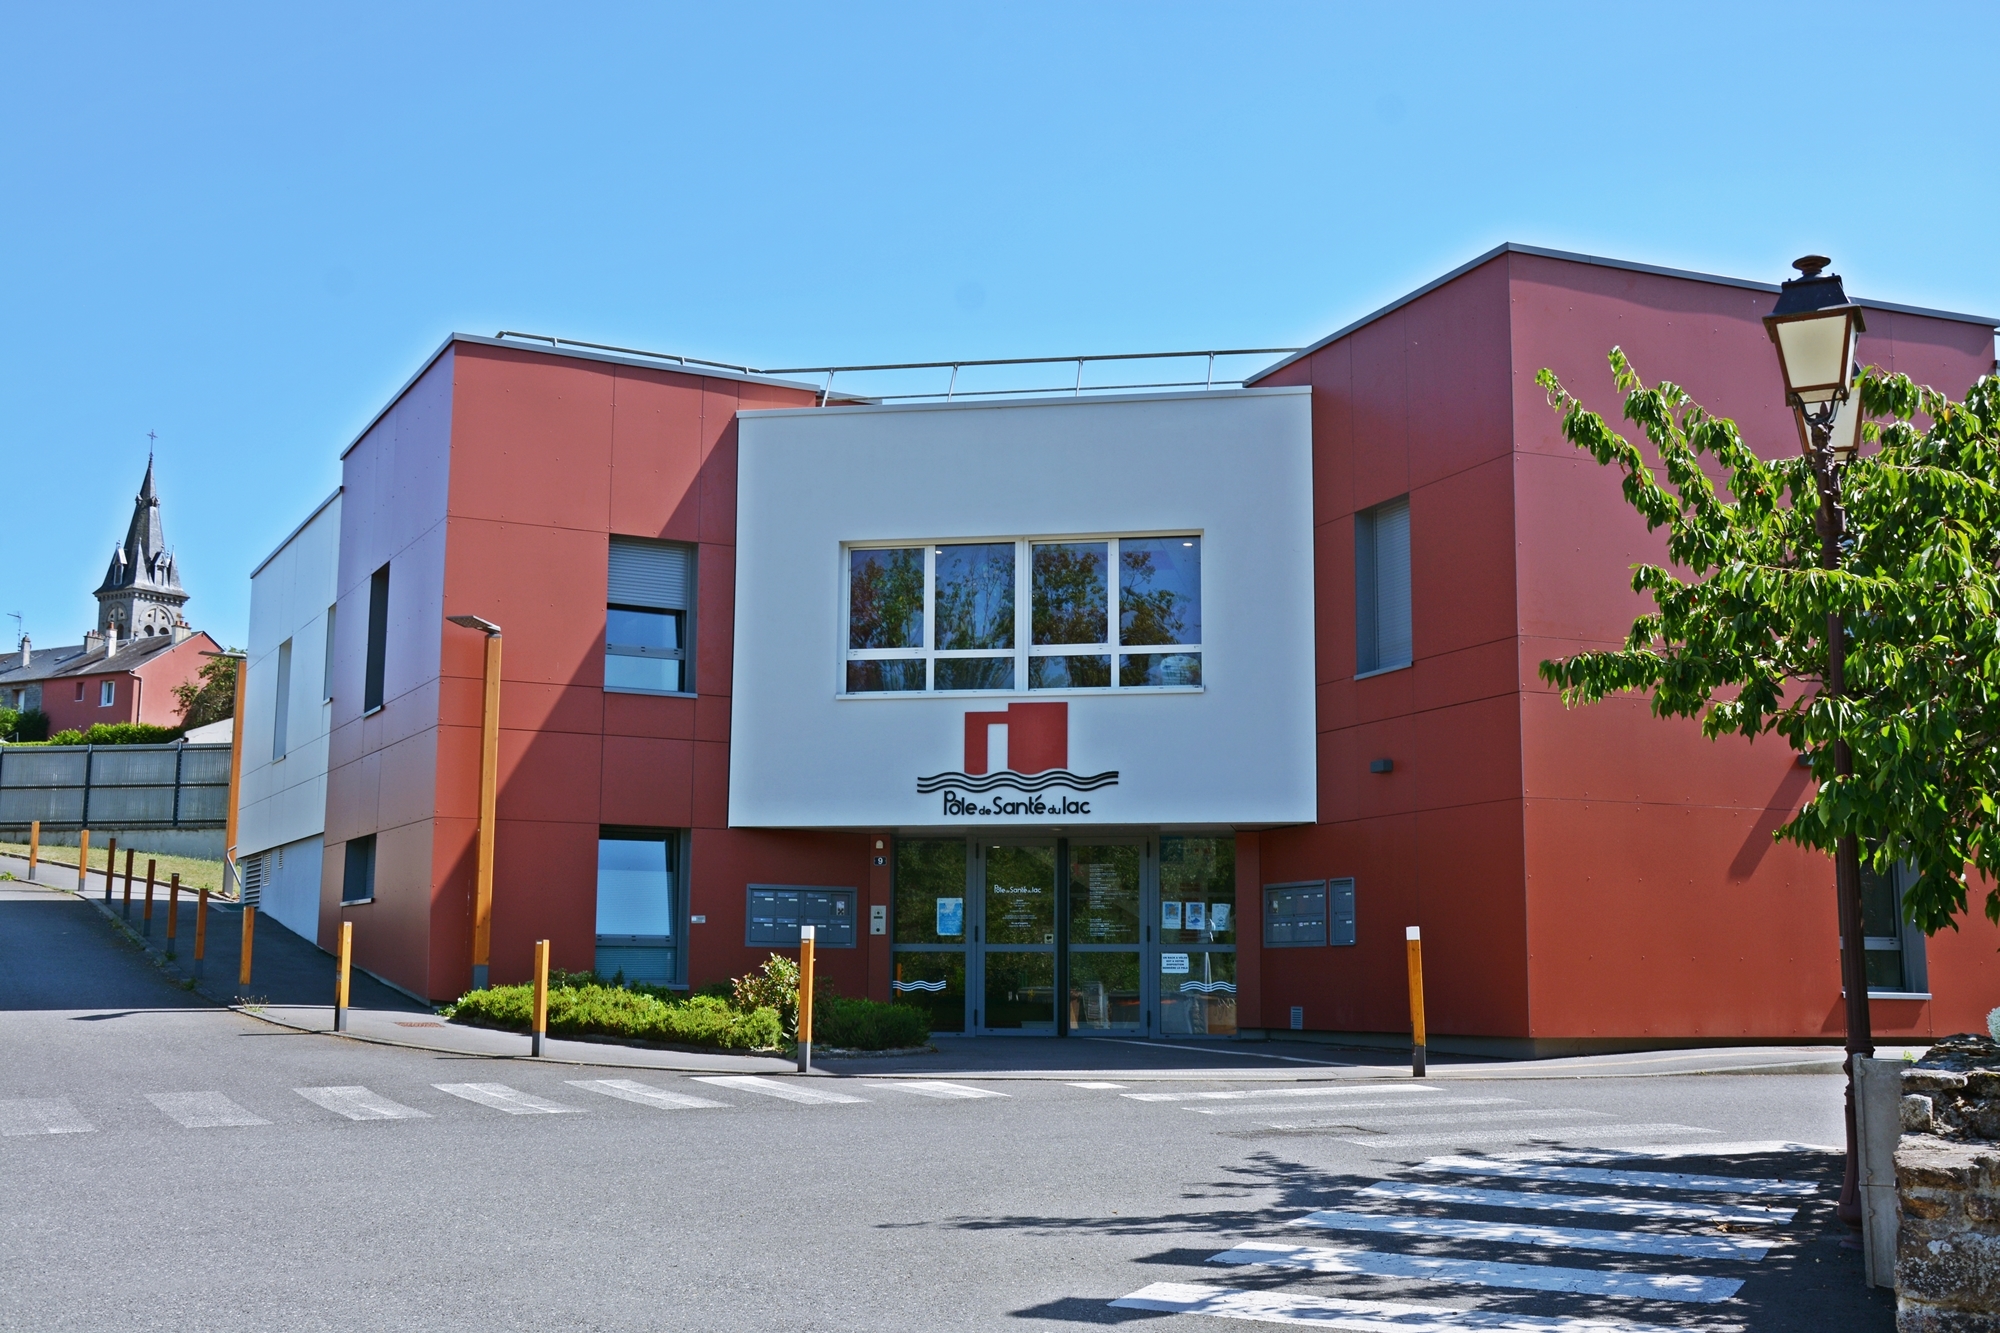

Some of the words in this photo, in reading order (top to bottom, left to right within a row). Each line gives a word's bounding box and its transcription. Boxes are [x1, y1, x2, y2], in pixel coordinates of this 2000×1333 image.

[944, 790, 977, 815] Pôle
[978, 805, 992, 815] de
[993, 794, 1046, 815] Santé
[1047, 804, 1061, 815] du
[1062, 796, 1091, 815] lac
